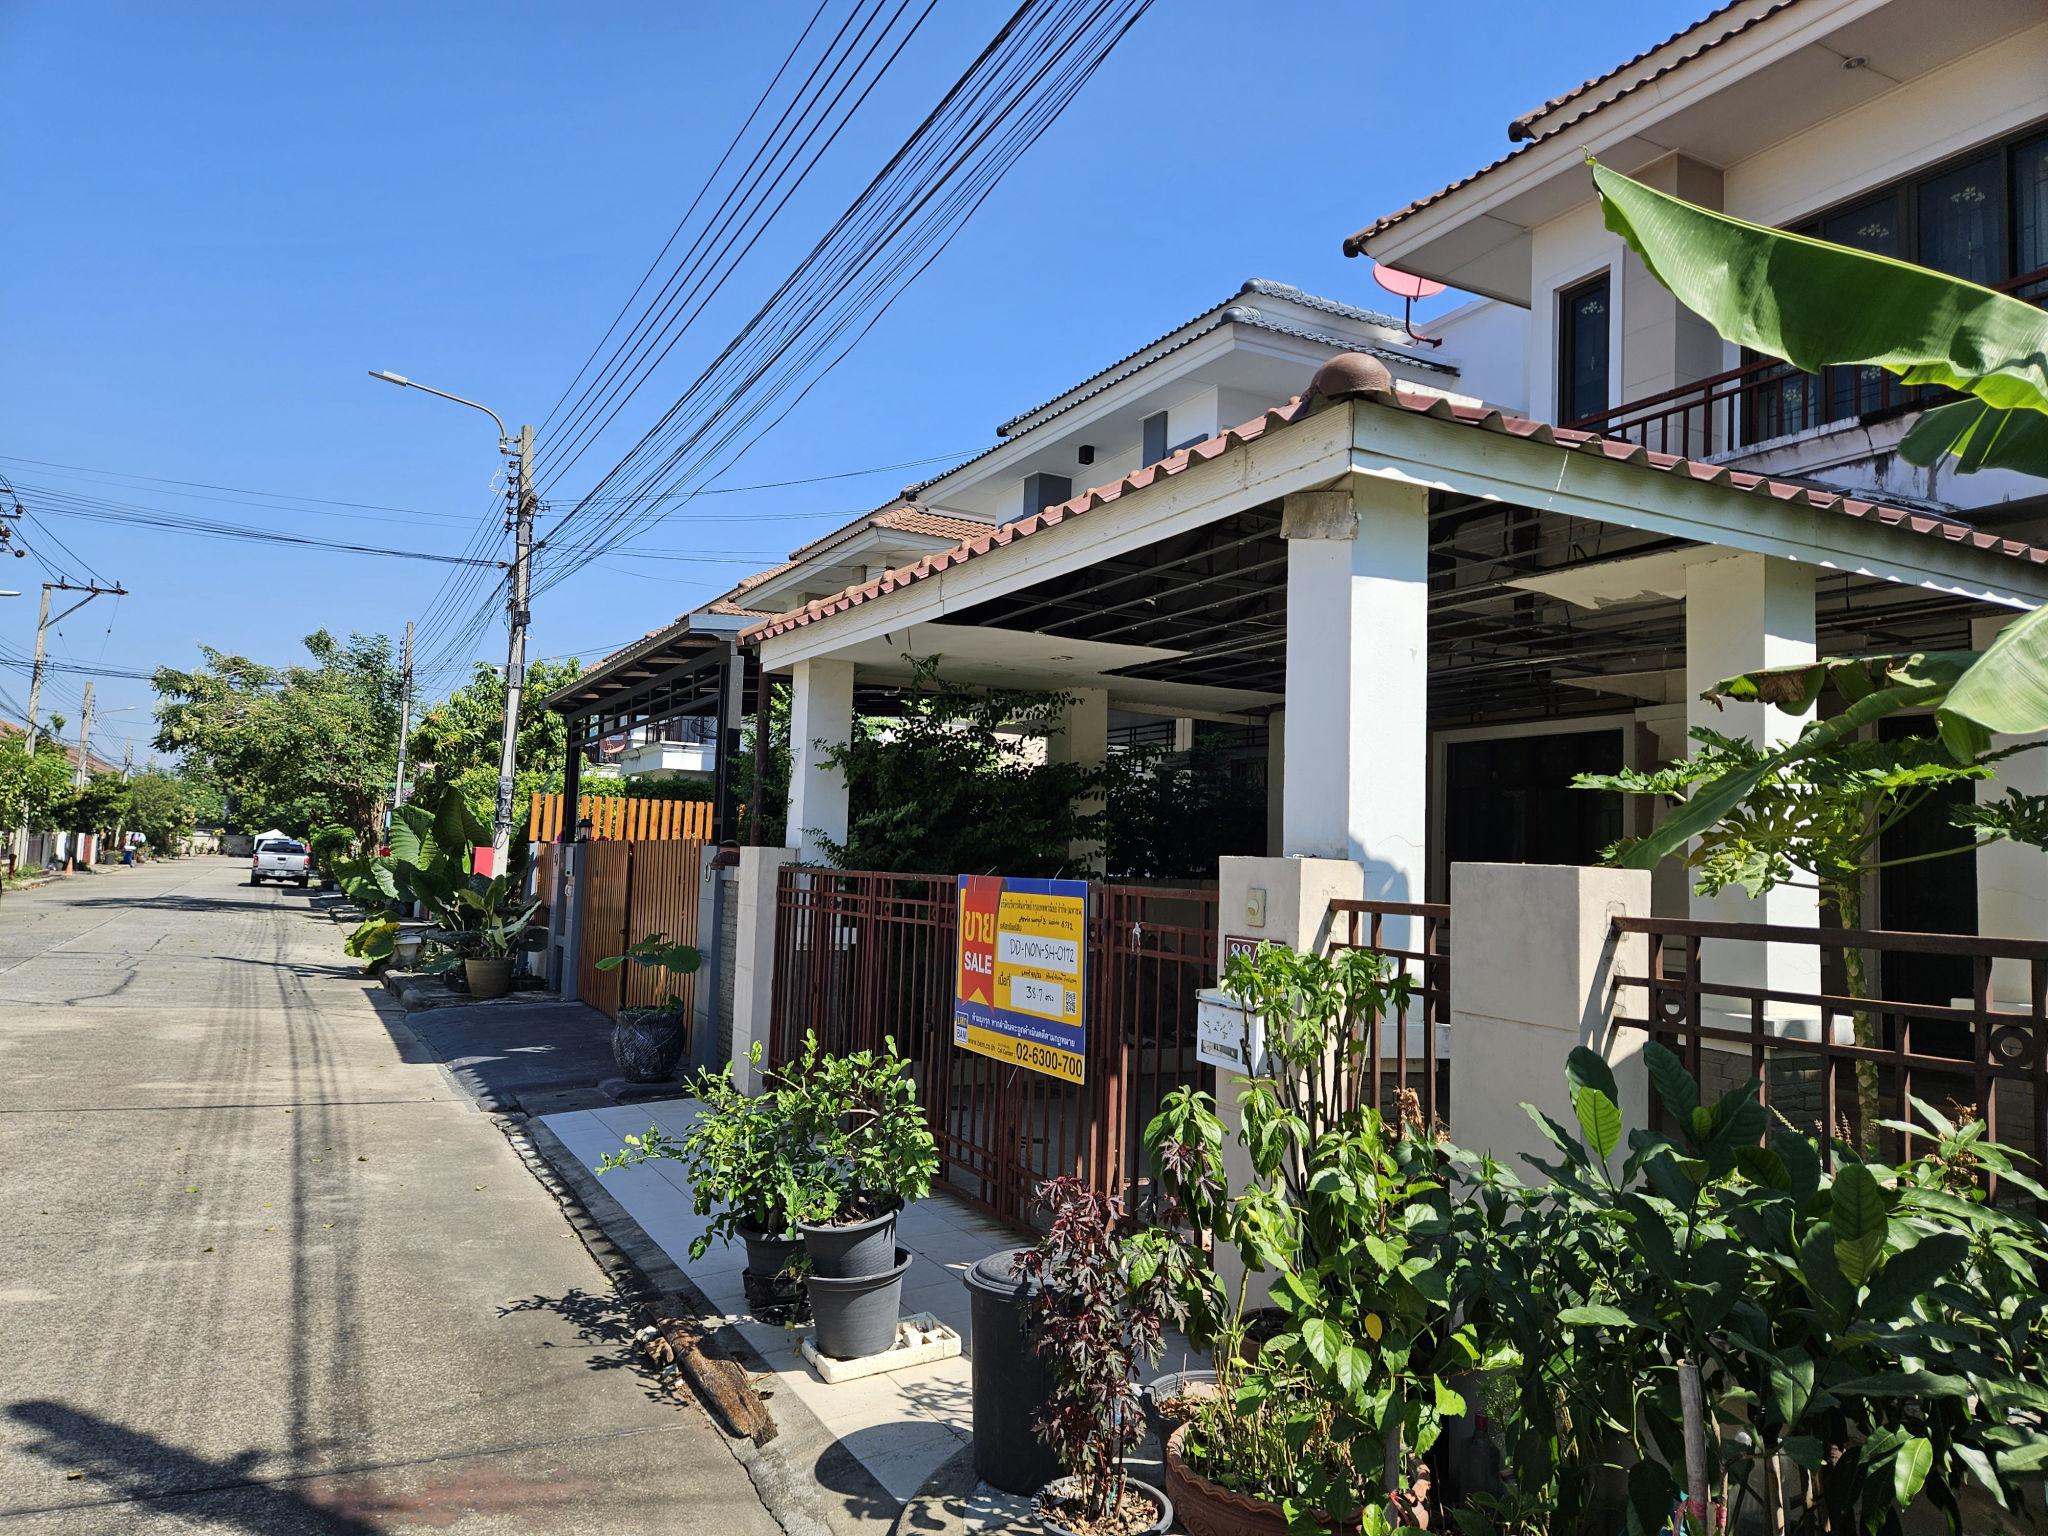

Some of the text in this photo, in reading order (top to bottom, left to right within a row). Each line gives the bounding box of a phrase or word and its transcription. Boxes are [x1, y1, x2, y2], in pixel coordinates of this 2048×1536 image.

[964, 910, 994, 944] ขาย
[1010, 938, 1074, 962] DD-NON-SH-0172
[964, 951, 992, 975] SALE
[957, 1027, 967, 1041] BAM
[1016, 1042, 1083, 1078] 02-6300-700
